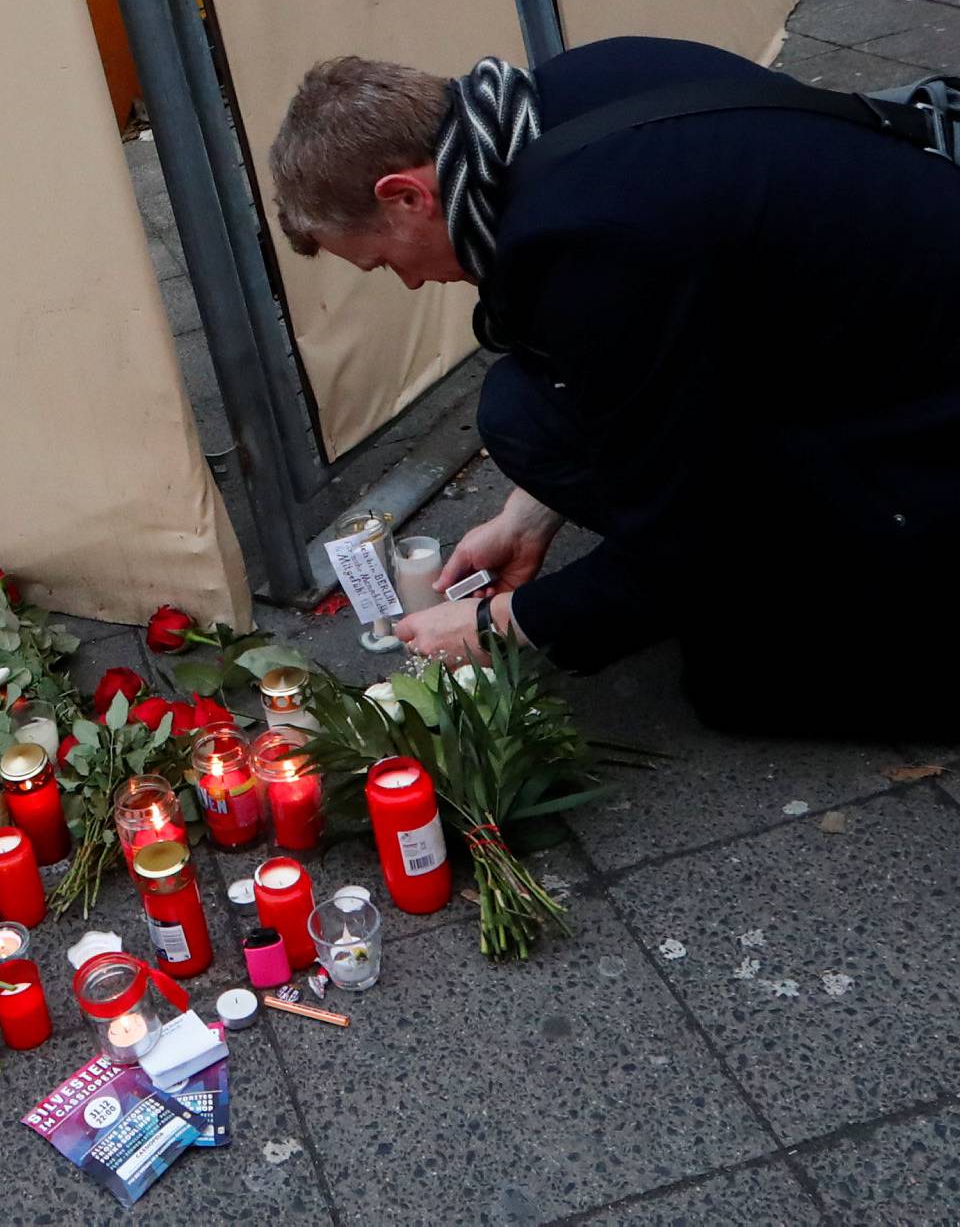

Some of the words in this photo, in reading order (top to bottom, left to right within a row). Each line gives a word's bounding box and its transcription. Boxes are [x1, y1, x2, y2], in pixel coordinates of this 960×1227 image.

[374, 573, 397, 605] BERLIN
[27, 1054, 112, 1124] SILVESTER
[39, 1117, 56, 1131] IM
[56, 1066, 121, 1117] CASSIOPEIA
[89, 1100, 110, 1119] 31.12
[96, 1105, 116, 1125] 22:00
